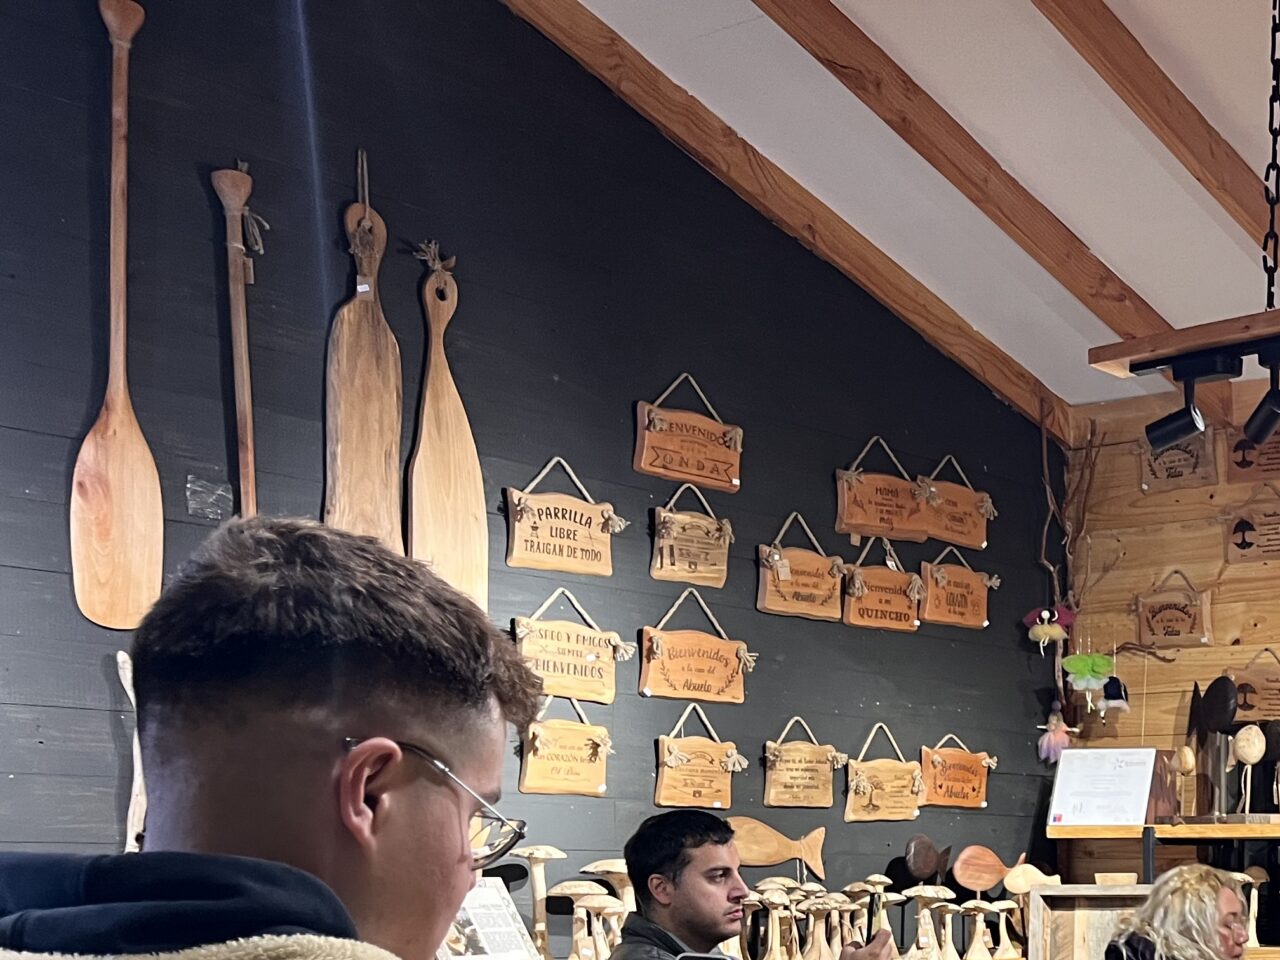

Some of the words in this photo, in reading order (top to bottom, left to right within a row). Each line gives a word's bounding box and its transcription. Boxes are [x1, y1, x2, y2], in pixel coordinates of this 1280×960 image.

[662, 453, 721, 476] ONDA
[535, 505, 593, 530] PARRILLA
[549, 525, 579, 542] LIBRE
[523, 539, 564, 558] TRAIGAN
[565, 544, 579, 560] DE
[580, 547, 603, 563] TODO
[857, 607, 911, 623] QUINCHO
[565, 631, 572, 643] Y
[667, 647, 732, 668] Bienvenidos
[535, 659, 605, 680] BIENVENIDOS
[682, 679, 713, 693] Abuelo
